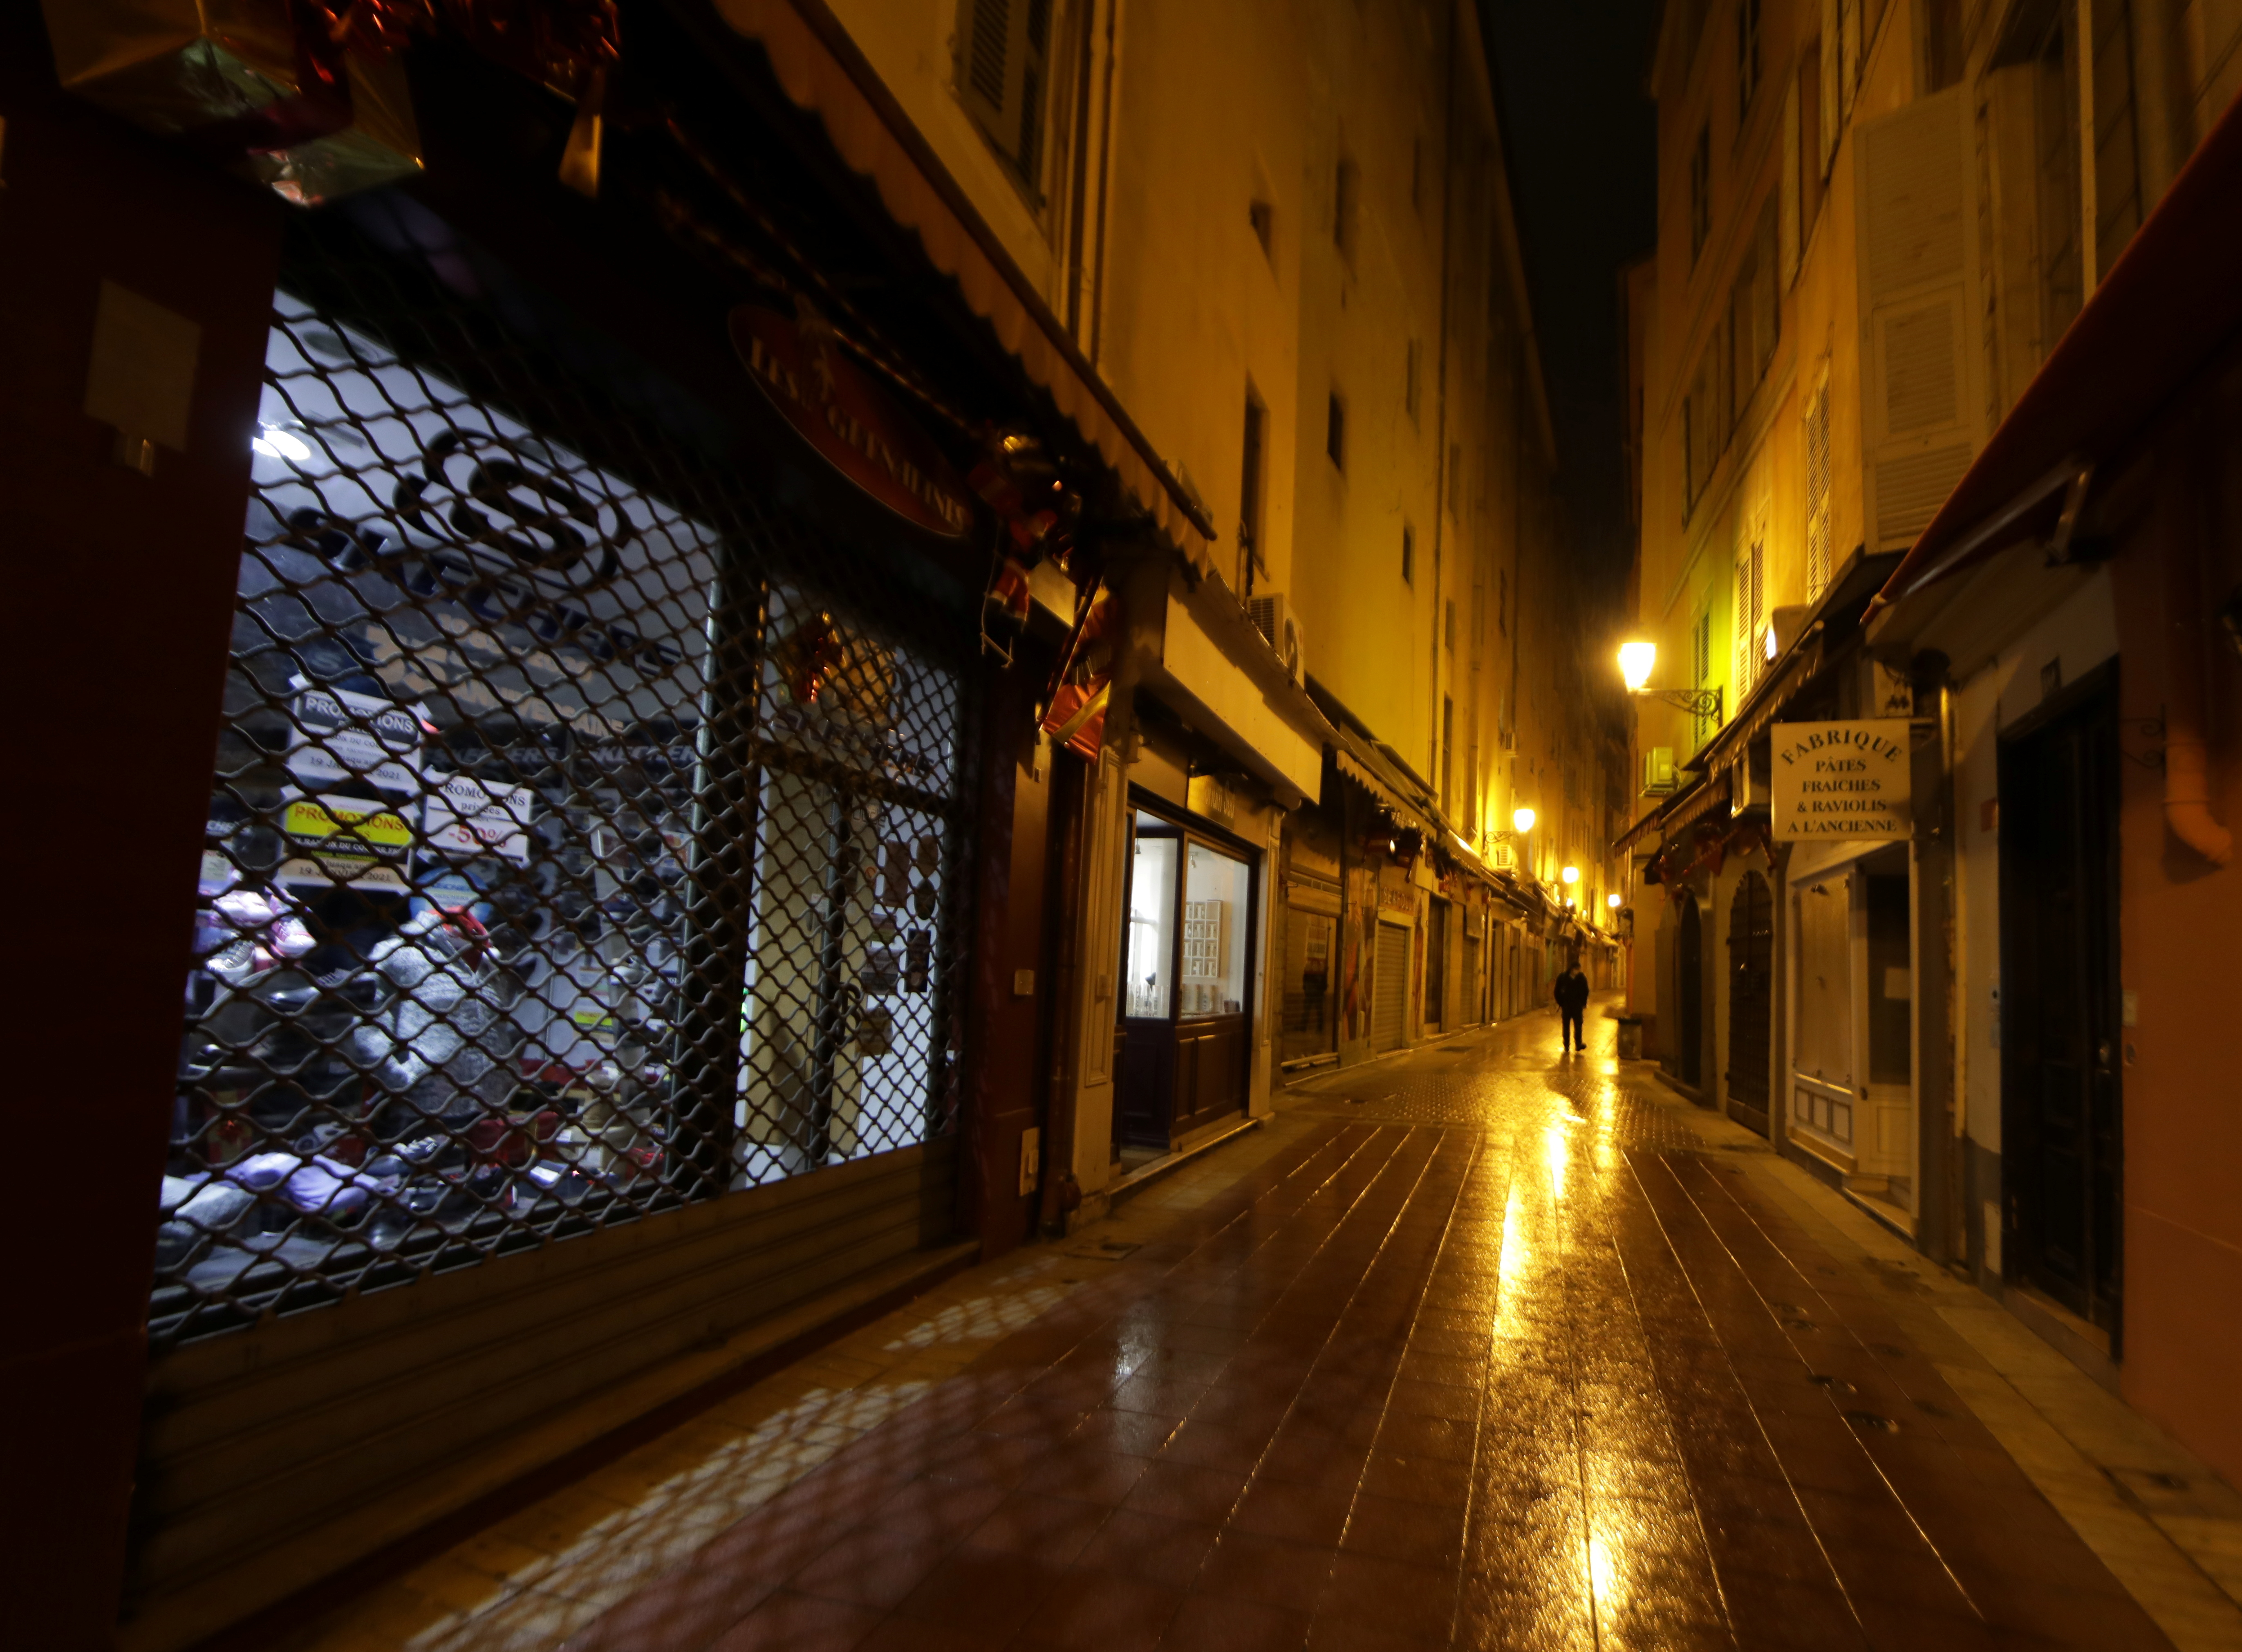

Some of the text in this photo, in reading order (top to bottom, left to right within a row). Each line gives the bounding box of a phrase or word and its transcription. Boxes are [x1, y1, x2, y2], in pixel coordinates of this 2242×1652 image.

[305, 697, 414, 735] PROIONS
[1781, 729, 1902, 766] FABRIQUE
[1816, 756, 1866, 772] PÂTES
[377, 769, 400, 779] 2021
[1802, 779, 1881, 793] FRAICHES
[441, 782, 526, 806] ROMONS
[1797, 799, 1887, 812] & RAVIOLIS
[295, 805, 404, 830] PROMOIONS
[1788, 819, 1897, 832] A L'ANCIENNE
[367, 872, 390, 881] 2021
